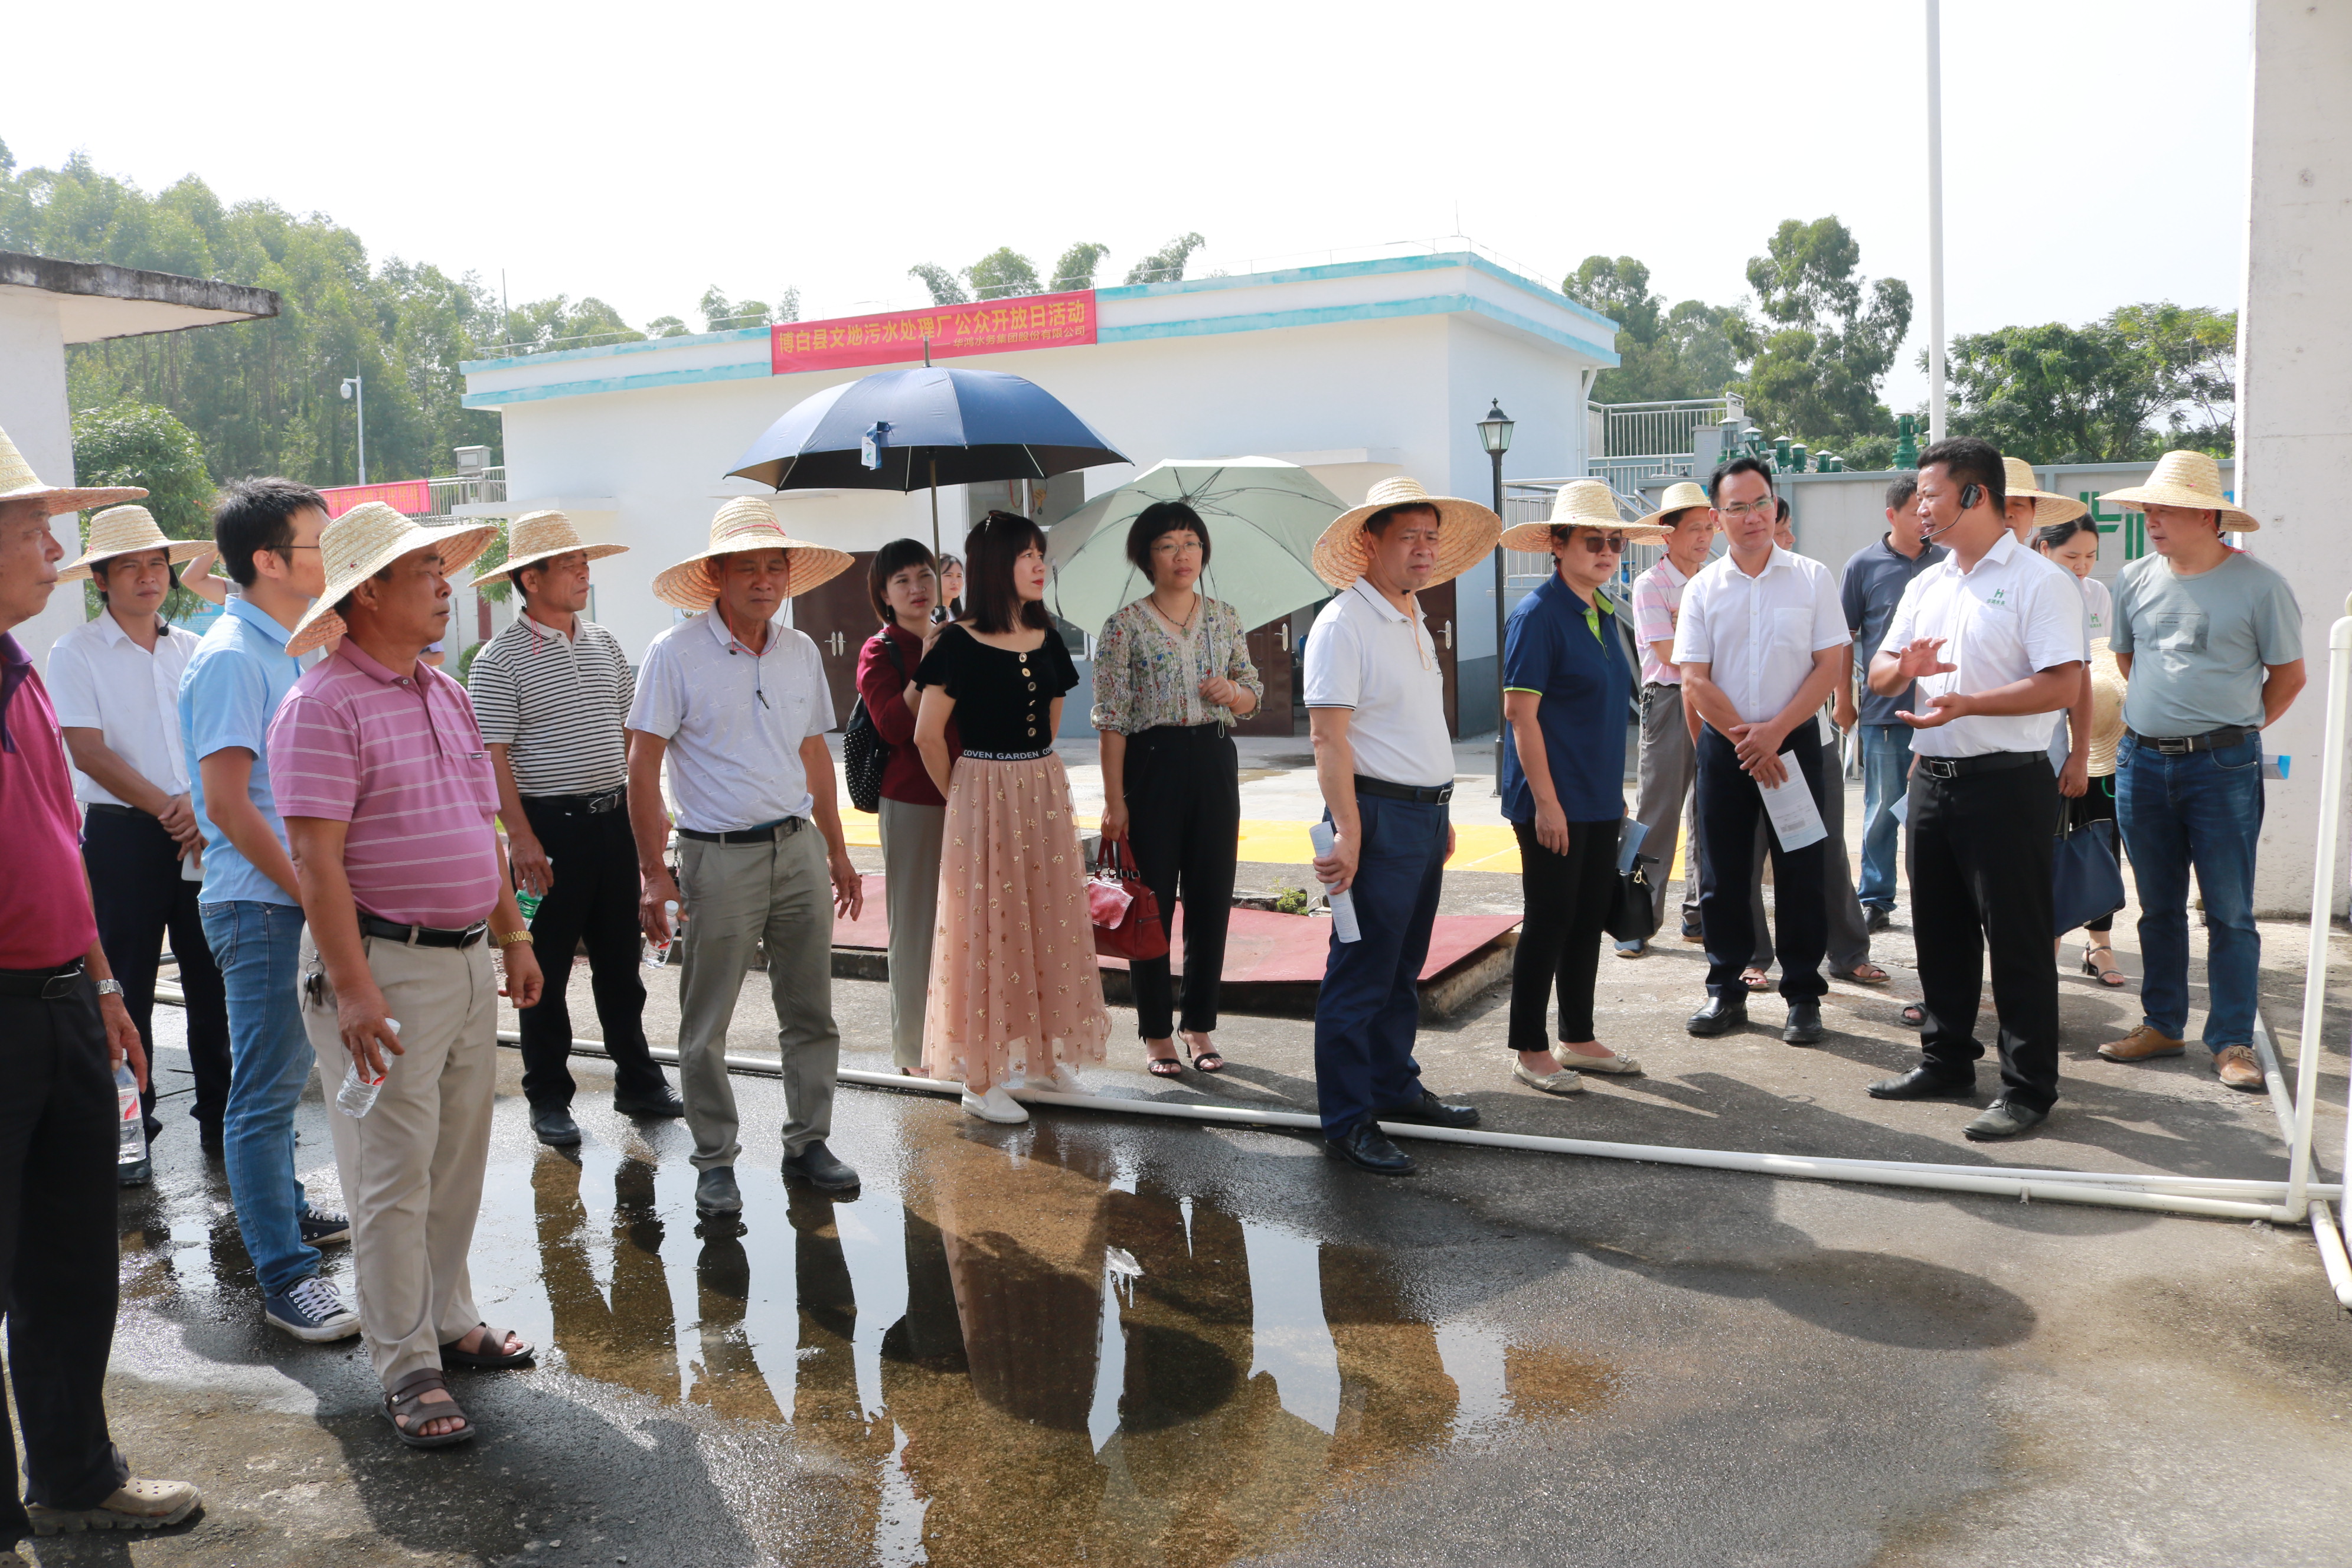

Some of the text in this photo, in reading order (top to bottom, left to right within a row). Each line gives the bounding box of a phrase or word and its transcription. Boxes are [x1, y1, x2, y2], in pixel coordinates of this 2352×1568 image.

[779, 299, 1085, 354] 博白县文地污水处理厂公众开放日活动
[963, 749, 993, 759] COVEN
[997, 750, 1040, 760] GARDEN
